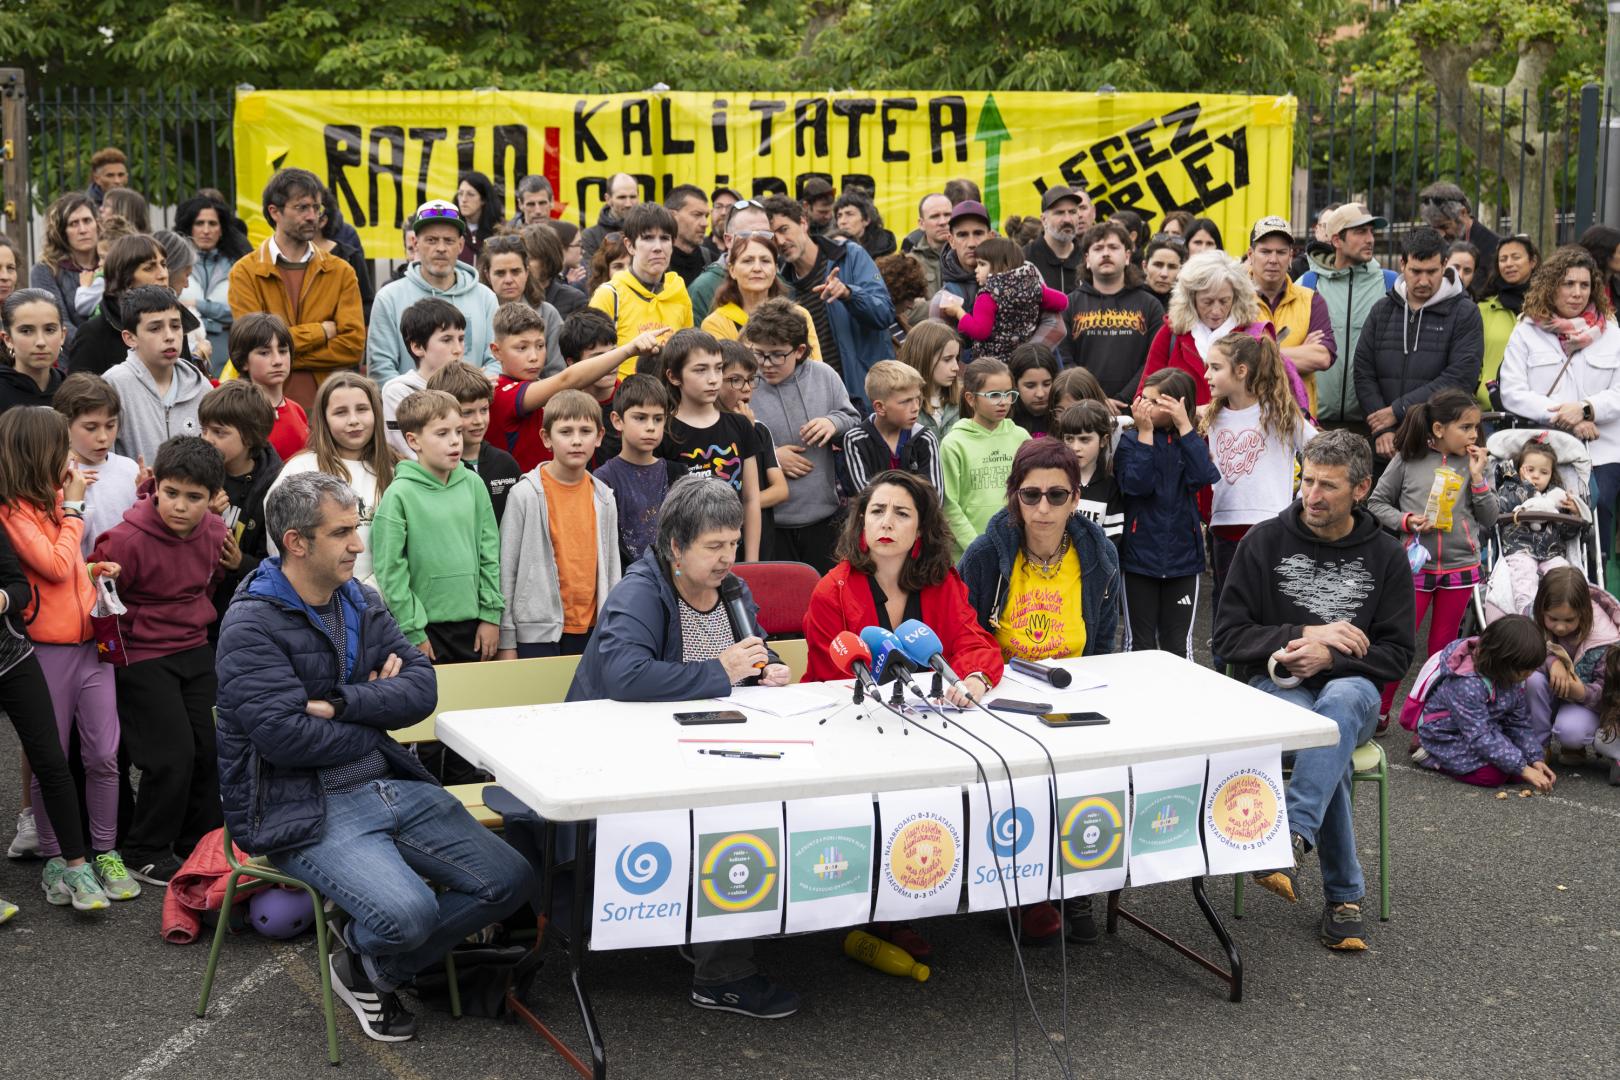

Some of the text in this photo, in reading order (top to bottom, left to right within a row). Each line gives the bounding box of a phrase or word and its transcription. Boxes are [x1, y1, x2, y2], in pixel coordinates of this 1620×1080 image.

[904, 626, 930, 643] tve
[875, 653, 886, 673] etb
[1208, 771, 1239, 809] NAFARROAKO
[1251, 769, 1282, 801] PLATAFORMA
[885, 815, 916, 856] NAFARROAKO
[931, 813, 961, 849] PLATAFORMA
[1208, 815, 1240, 850] PLATAFORMA
[1266, 809, 1284, 841] NAVARRA
[884, 863, 912, 899] PLATAFORMA
[929, 889, 937, 897] DE
[939, 857, 961, 890] NAVARRA
[974, 862, 1043, 884] Sortzen
[600, 902, 682, 922] Sortzen
